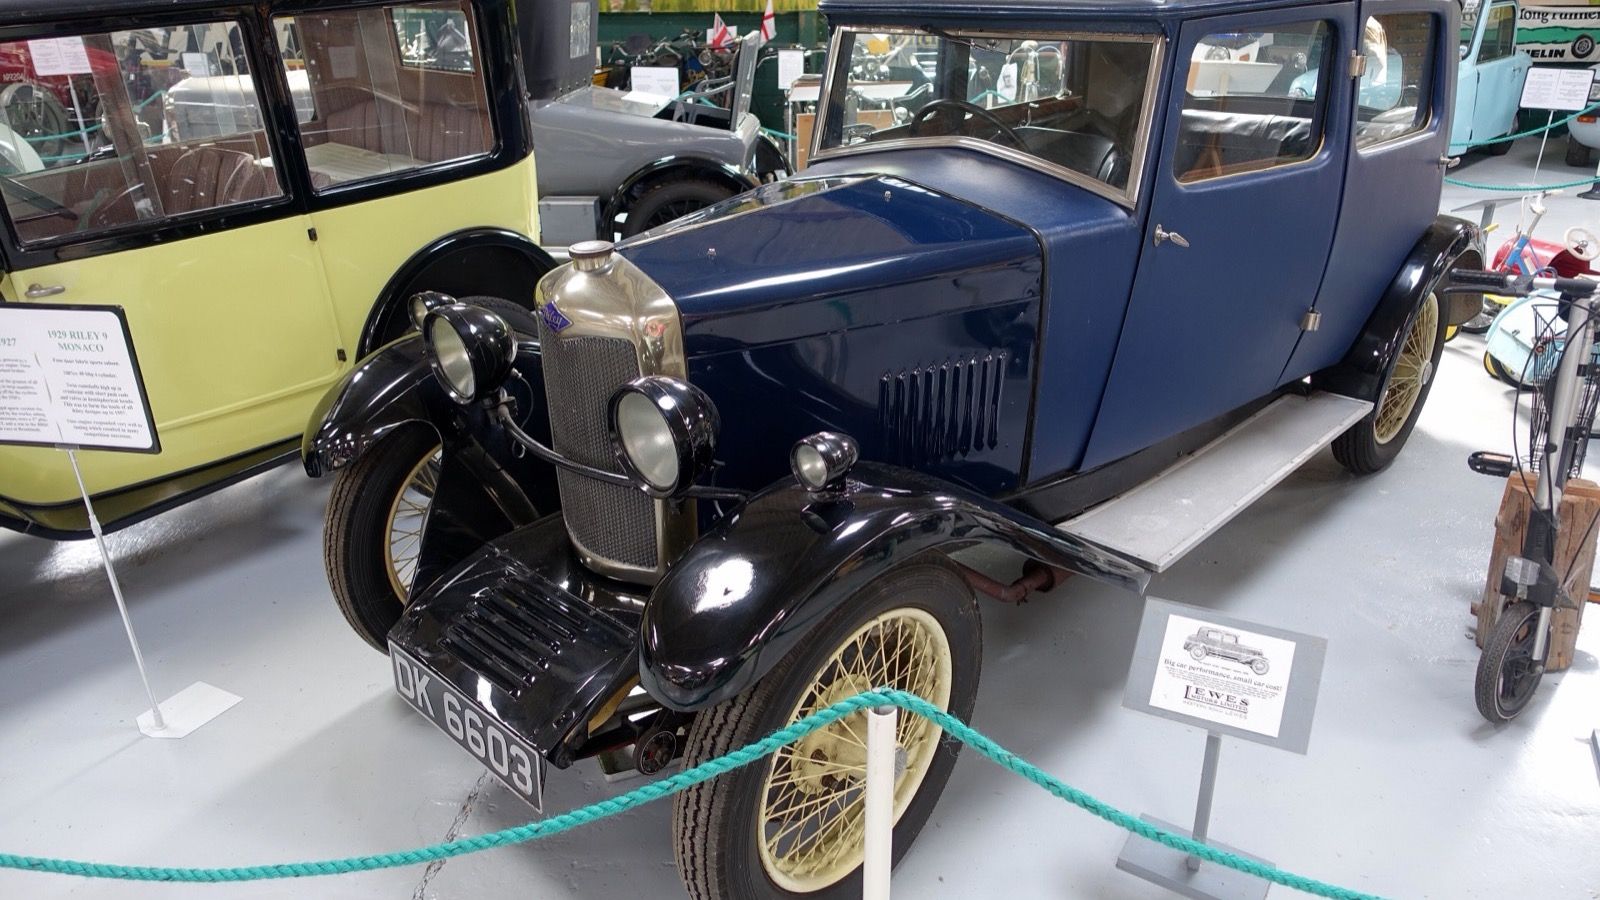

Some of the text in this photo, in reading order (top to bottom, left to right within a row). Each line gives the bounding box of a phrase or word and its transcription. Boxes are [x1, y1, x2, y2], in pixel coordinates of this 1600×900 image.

[48, 329, 108, 341] 1929 RILEY 9
[58, 342, 104, 353] MONACO
[394, 652, 533, 795] DK 6603
